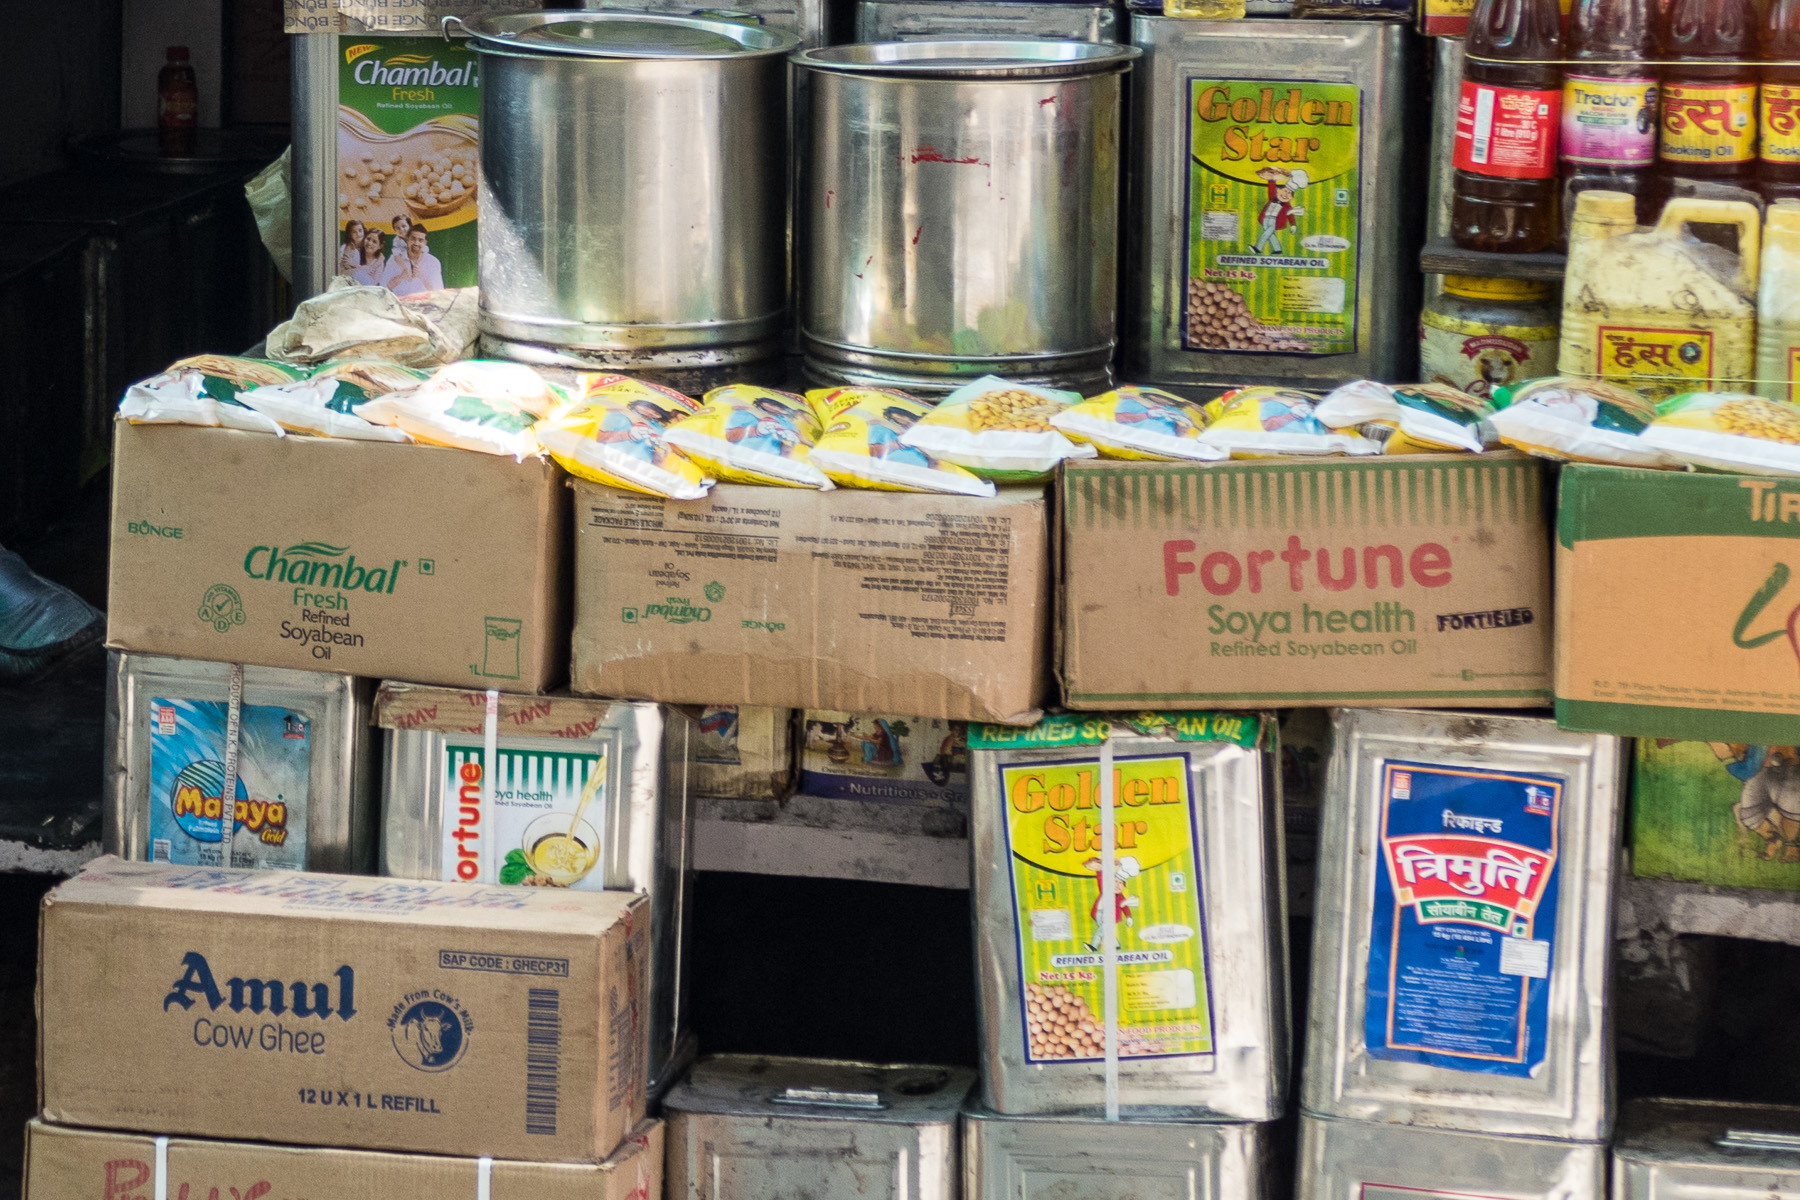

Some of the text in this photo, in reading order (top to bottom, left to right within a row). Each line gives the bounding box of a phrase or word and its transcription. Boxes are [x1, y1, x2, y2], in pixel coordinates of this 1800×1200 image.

[354, 60, 472, 87] Chambal
[392, 87, 435, 101] Fresh
[1197, 86, 1354, 127] Golden
[1662, 89, 1743, 137] हंस
[1221, 125, 1320, 163] Star
[1715, 142, 1734, 158] Oil
[1220, 255, 1326, 268] REFINED SOYABEAN OIL
[1613, 336, 1673, 369] हंस
[243, 545, 401, 595] Chambal
[1163, 535, 1454, 597] Fortune
[294, 587, 349, 611] Fresh
[301, 609, 350, 628] Refined
[1207, 600, 1416, 641] Soya health
[1437, 607, 1536, 633] FORTIFIED
[280, 621, 364, 649] Soyabean
[1210, 637, 1417, 659] Refined Soyabean Oil
[312, 645, 331, 660] Oil
[225, 752, 236, 800] PROTEINS
[517, 788, 553, 803] health
[443, 953, 566, 973] SAP CODE GHECP31
[1056, 951, 1169, 966] REFINED OIL
[164, 952, 358, 1022] Amul
[194, 1018, 325, 1054] Cow Ghee
[298, 1089, 316, 1104] 12
[321, 1089, 332, 1106] U
[337, 1091, 348, 1106] X
[382, 1095, 440, 1114] REFILL
